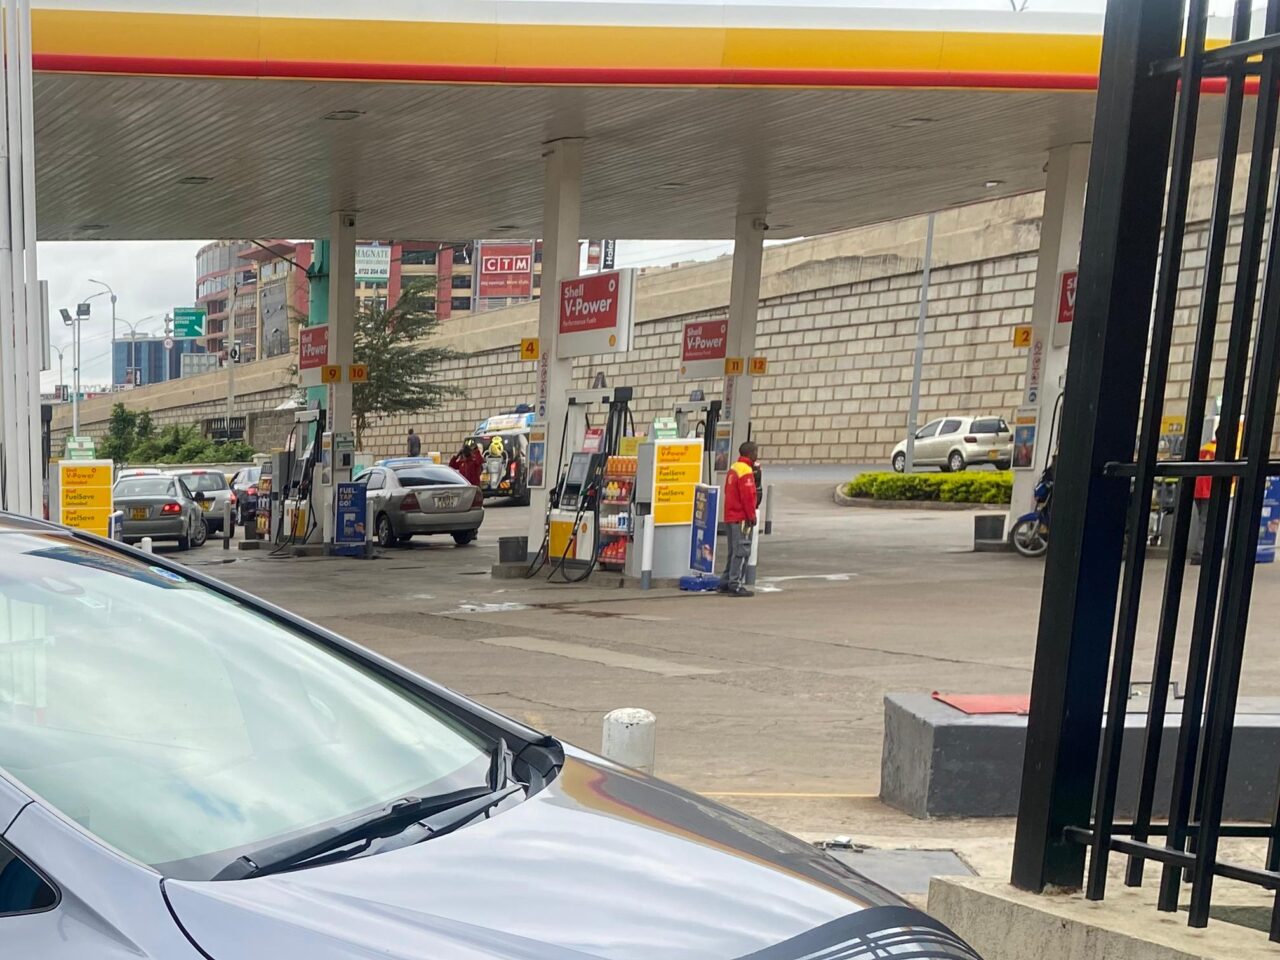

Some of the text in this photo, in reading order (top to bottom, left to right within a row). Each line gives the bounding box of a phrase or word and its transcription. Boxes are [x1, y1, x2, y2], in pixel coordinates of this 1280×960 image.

[486, 258, 527, 271] CTM
[564, 284, 584, 299] Shell
[564, 298, 612, 317] V-Power
[687, 326, 703, 337] Shell
[1022, 330, 1030, 342] 2
[526, 342, 535, 354] 4
[687, 336, 723, 350] V-Power
[301, 343, 327, 358] V-Power
[732, 361, 739, 371] 11
[753, 360, 764, 370] 12
[329, 368, 337, 379] 9
[352, 367, 363, 378] 10
